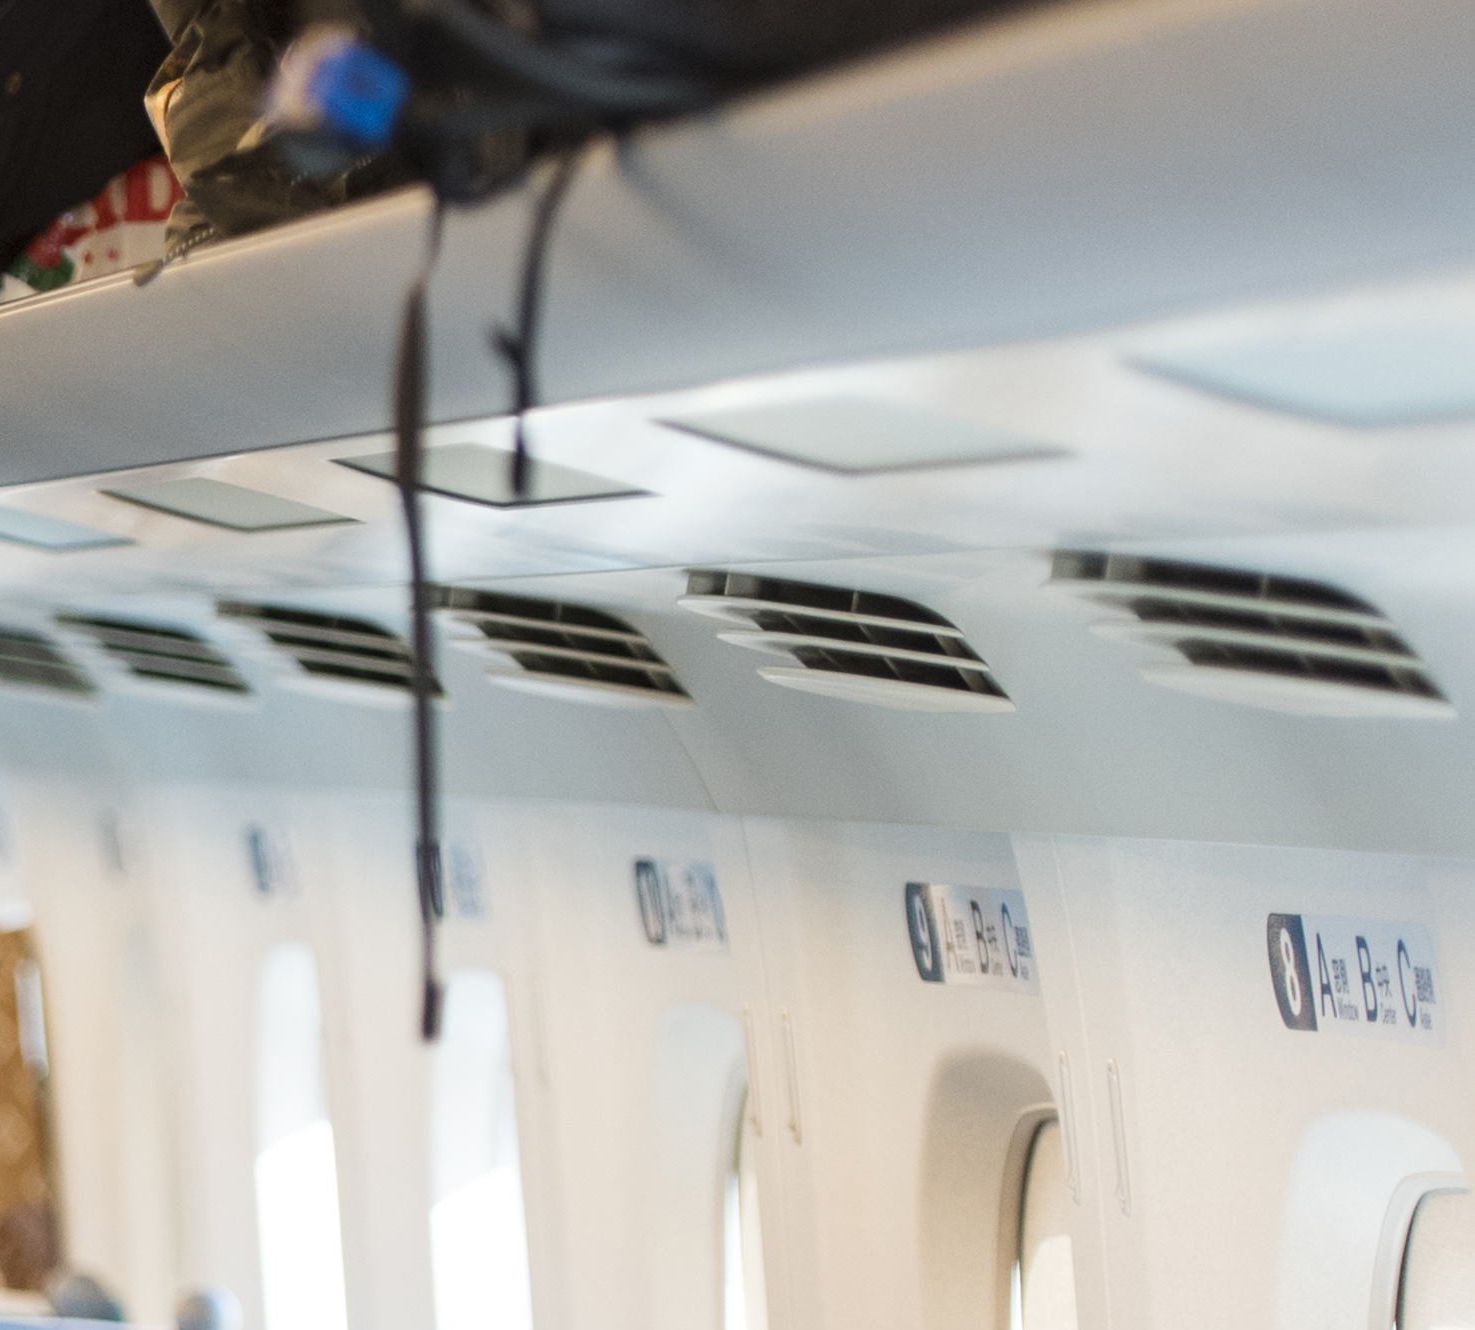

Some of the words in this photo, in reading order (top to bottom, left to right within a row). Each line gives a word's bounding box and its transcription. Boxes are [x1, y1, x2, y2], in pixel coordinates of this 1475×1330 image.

[915, 895, 933, 972] 9
[941, 898, 961, 973] A
[970, 899, 989, 974] B
[1001, 902, 1019, 978] C
[1280, 928, 1302, 1016] 8
[1316, 932, 1337, 1018] A
[1355, 935, 1378, 1022] B
[1397, 938, 1417, 1028] C
